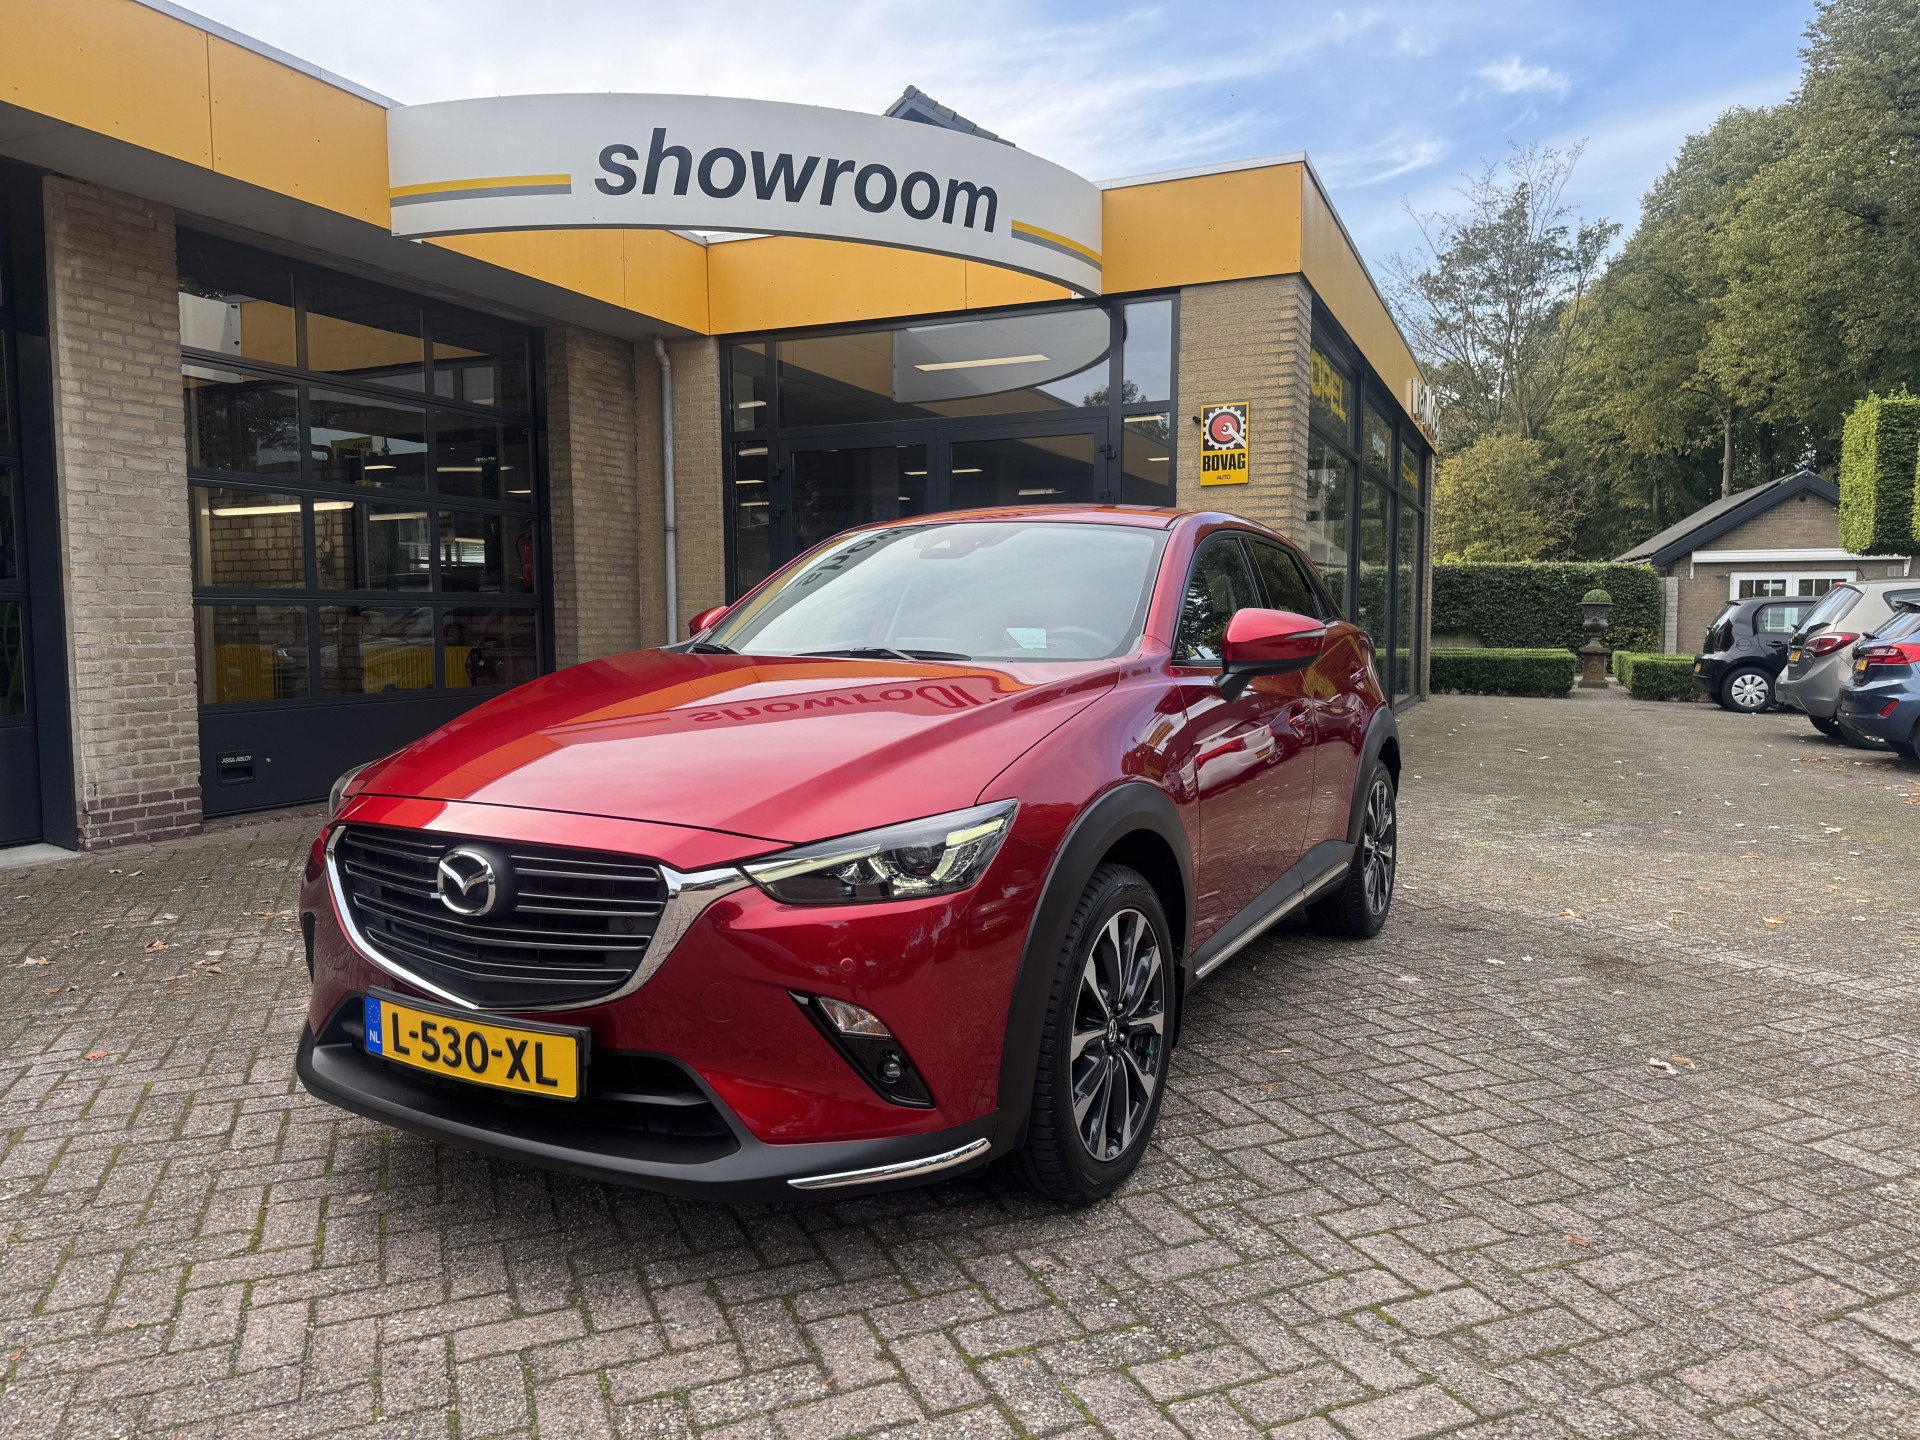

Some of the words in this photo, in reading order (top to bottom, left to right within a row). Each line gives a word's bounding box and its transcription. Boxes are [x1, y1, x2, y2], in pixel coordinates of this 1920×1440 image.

[594, 127, 998, 233] showroom
[1310, 347, 1347, 423] OPEL
[1202, 452, 1246, 472] BOVAG
[369, 1029, 381, 1044] NL
[391, 1012, 558, 1087] L-530-XL
